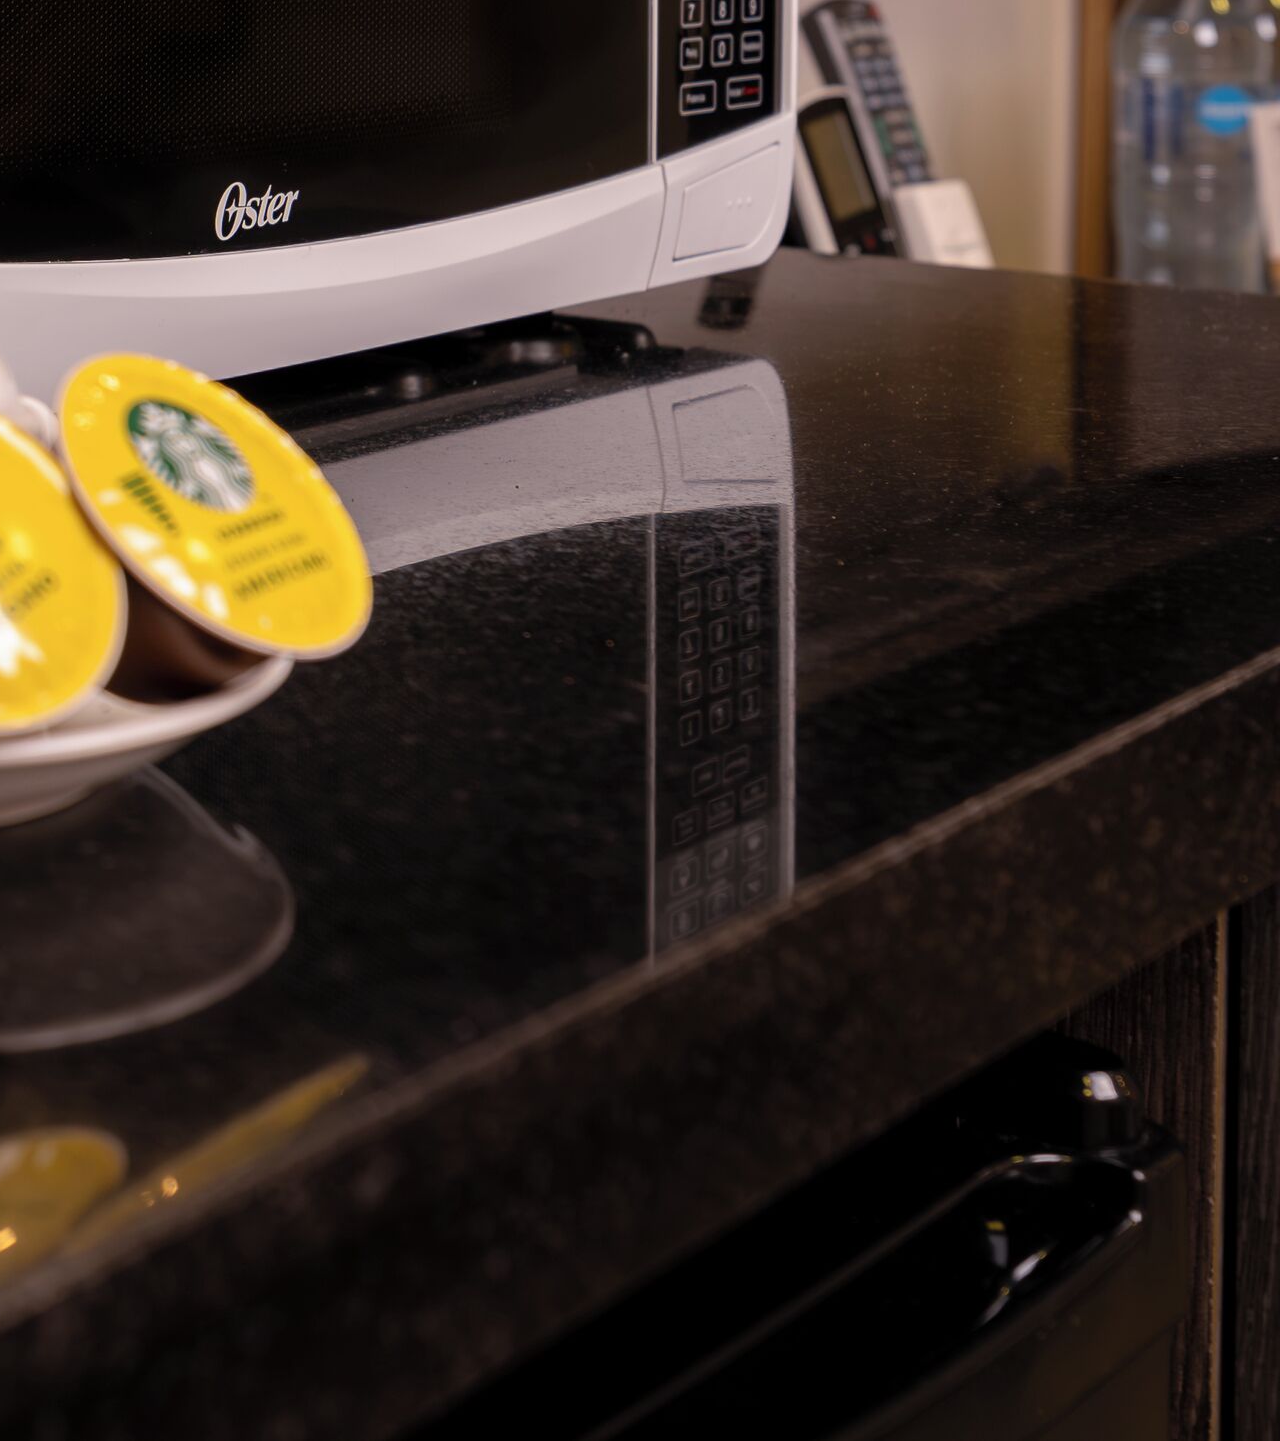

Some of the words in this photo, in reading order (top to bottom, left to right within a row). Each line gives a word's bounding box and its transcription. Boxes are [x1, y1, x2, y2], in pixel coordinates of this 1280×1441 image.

[688, 3, 695, 21] 7
[718, 0, 727, 18] 8
[718, 40, 726, 59] 0
[214, 181, 300, 241] Oster
